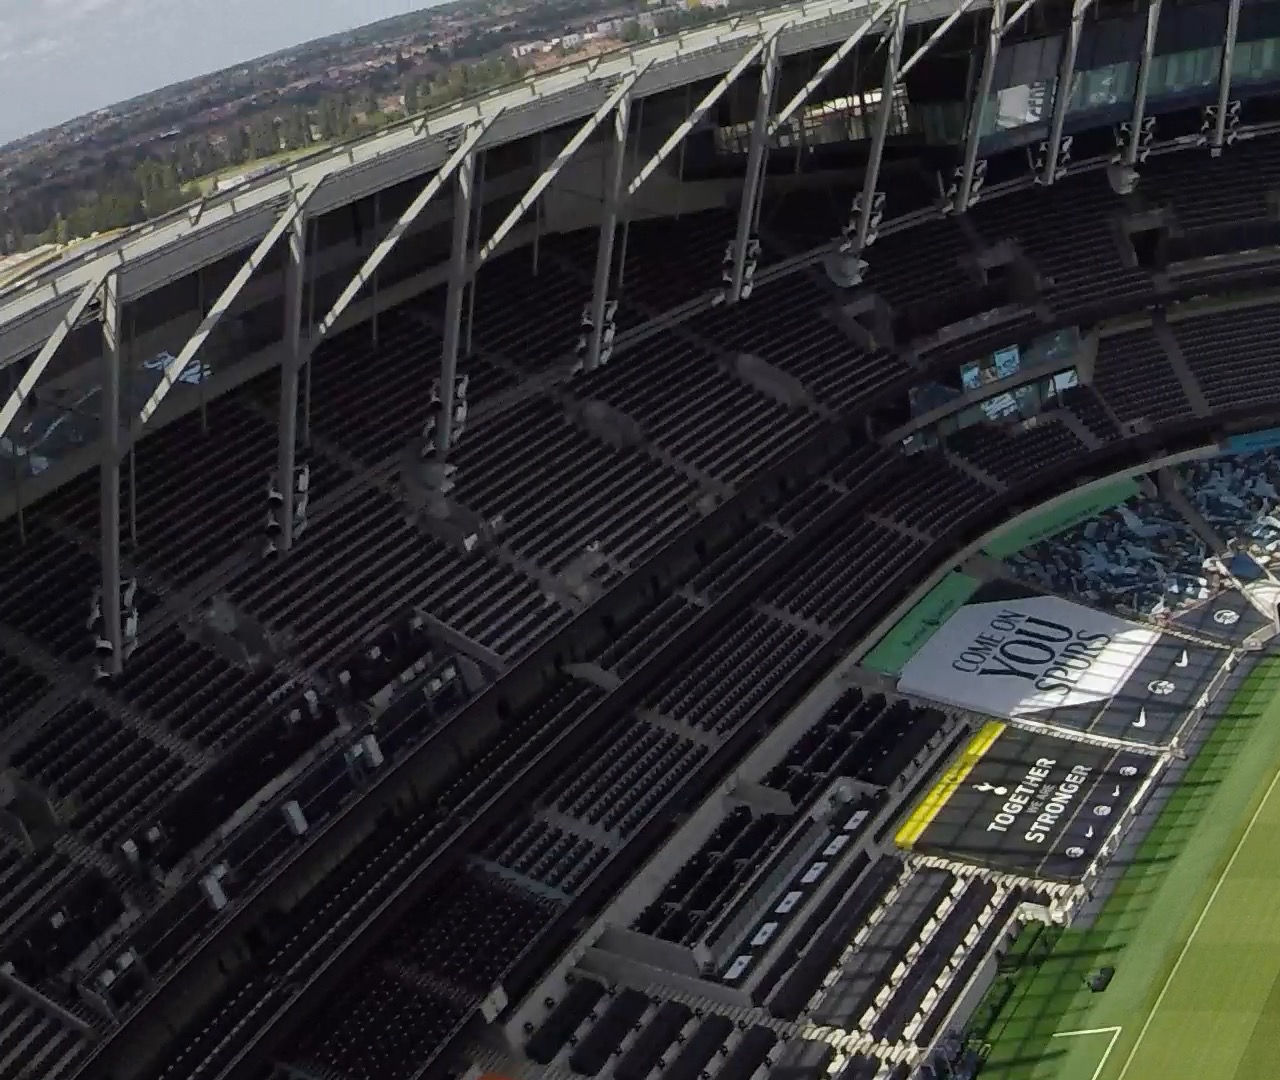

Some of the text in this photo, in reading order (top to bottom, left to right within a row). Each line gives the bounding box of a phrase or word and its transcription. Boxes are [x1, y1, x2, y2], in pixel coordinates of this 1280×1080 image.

[952, 608, 1028, 673] COME ON
[976, 615, 1073, 681] YOU
[1034, 629, 1112, 696] SPURS
[986, 757, 1057, 832] TOGETHER
[1024, 764, 1093, 844] STRONGER
